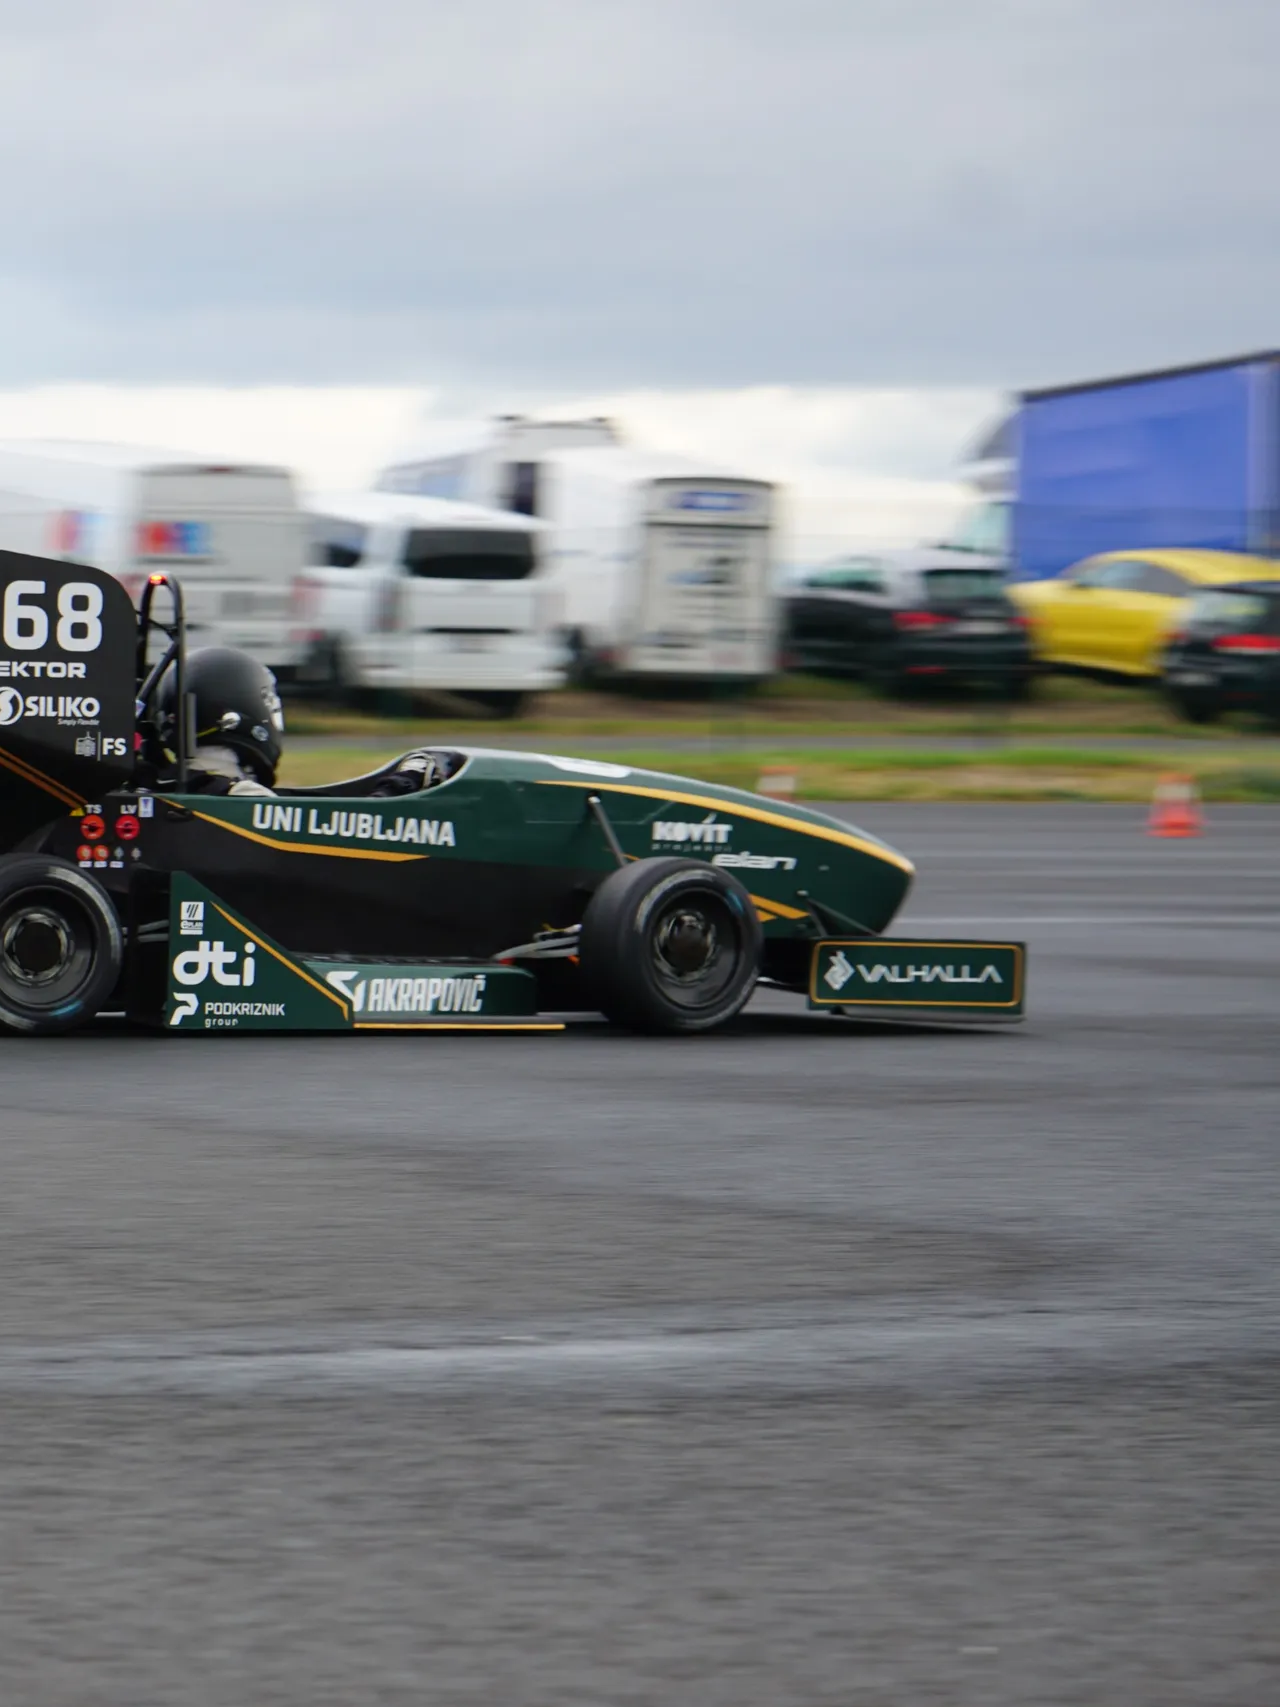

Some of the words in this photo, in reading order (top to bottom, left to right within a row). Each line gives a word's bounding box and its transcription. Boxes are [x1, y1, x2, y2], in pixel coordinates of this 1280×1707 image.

[24, 696, 100, 718] SILIKO
[102, 738, 127, 756] FS
[84, 804, 102, 814] TS
[120, 805, 137, 814] LV
[252, 803, 302, 833] UNI
[308, 809, 456, 847] LJUBLJANA
[172, 940, 256, 987] dti
[856, 964, 1004, 983] VALHALLA
[204, 1002, 286, 1016] PODKRIZNIK
